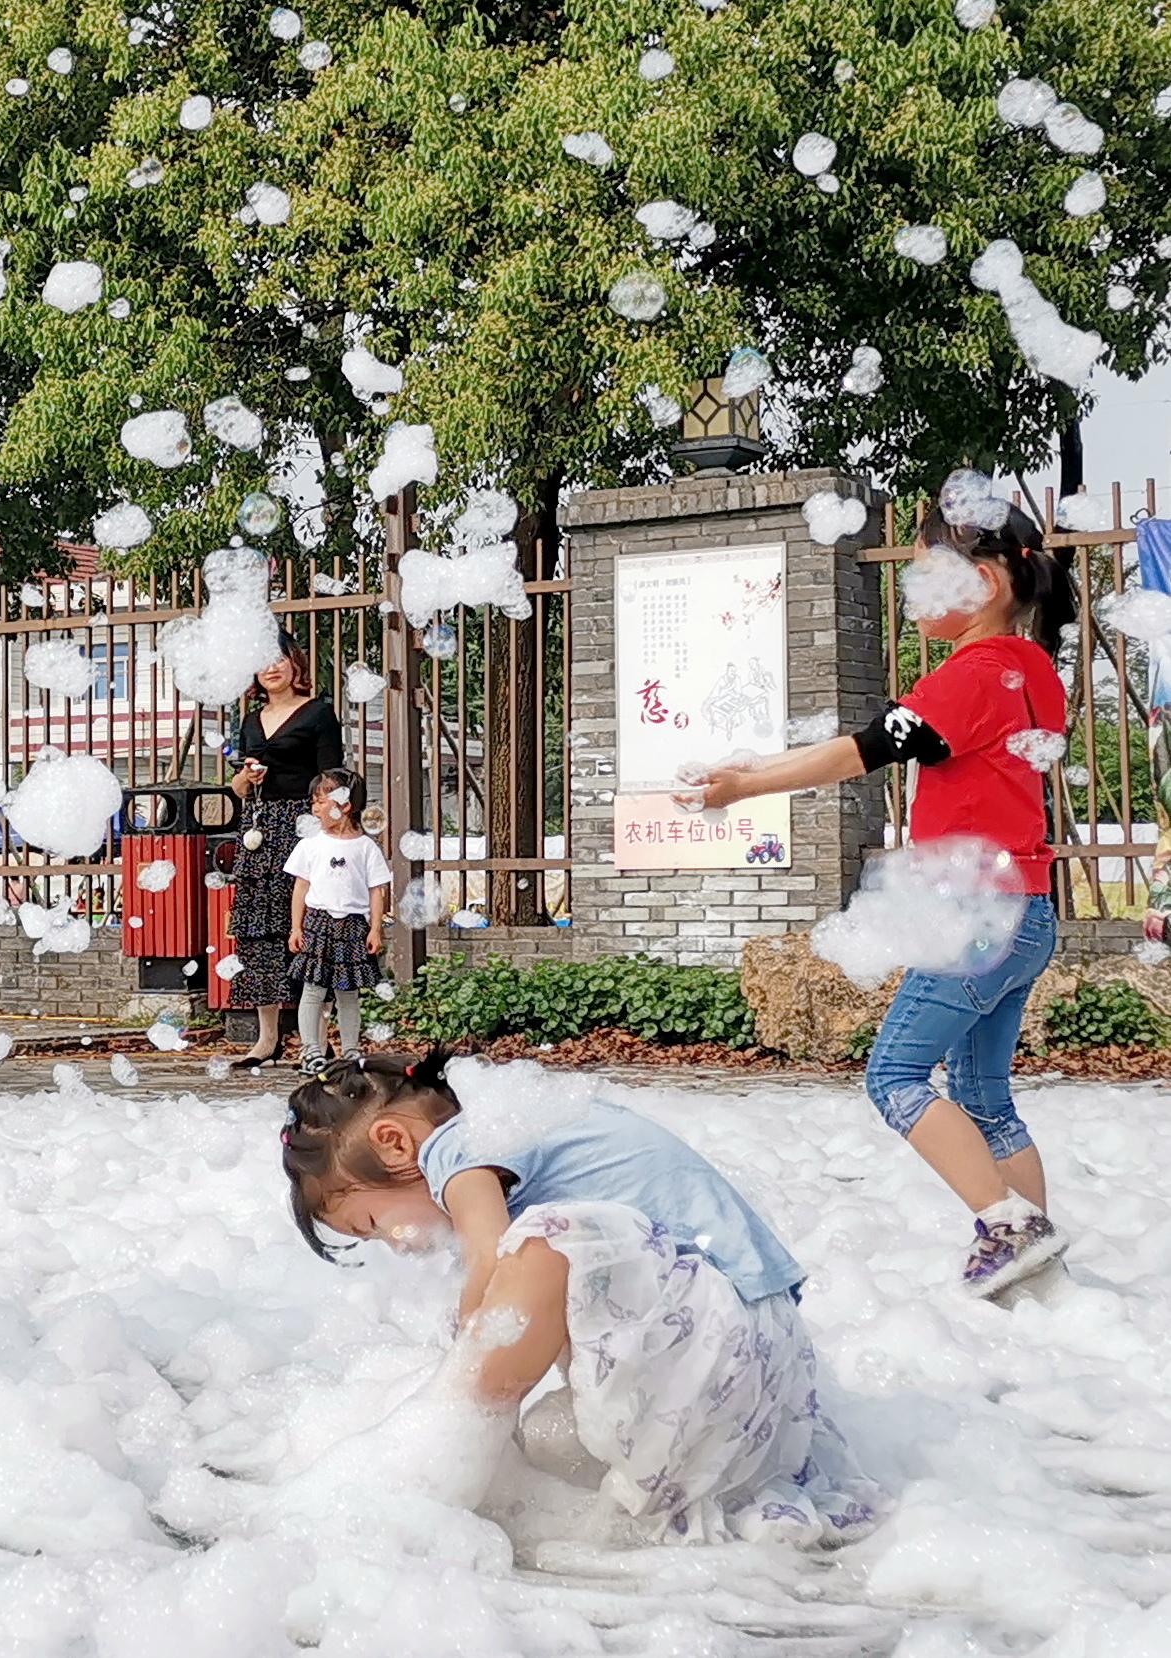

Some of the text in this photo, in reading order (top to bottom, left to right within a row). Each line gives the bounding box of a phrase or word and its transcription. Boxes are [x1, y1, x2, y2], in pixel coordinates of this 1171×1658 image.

[624, 818, 755, 844] 农机车位(6)号
